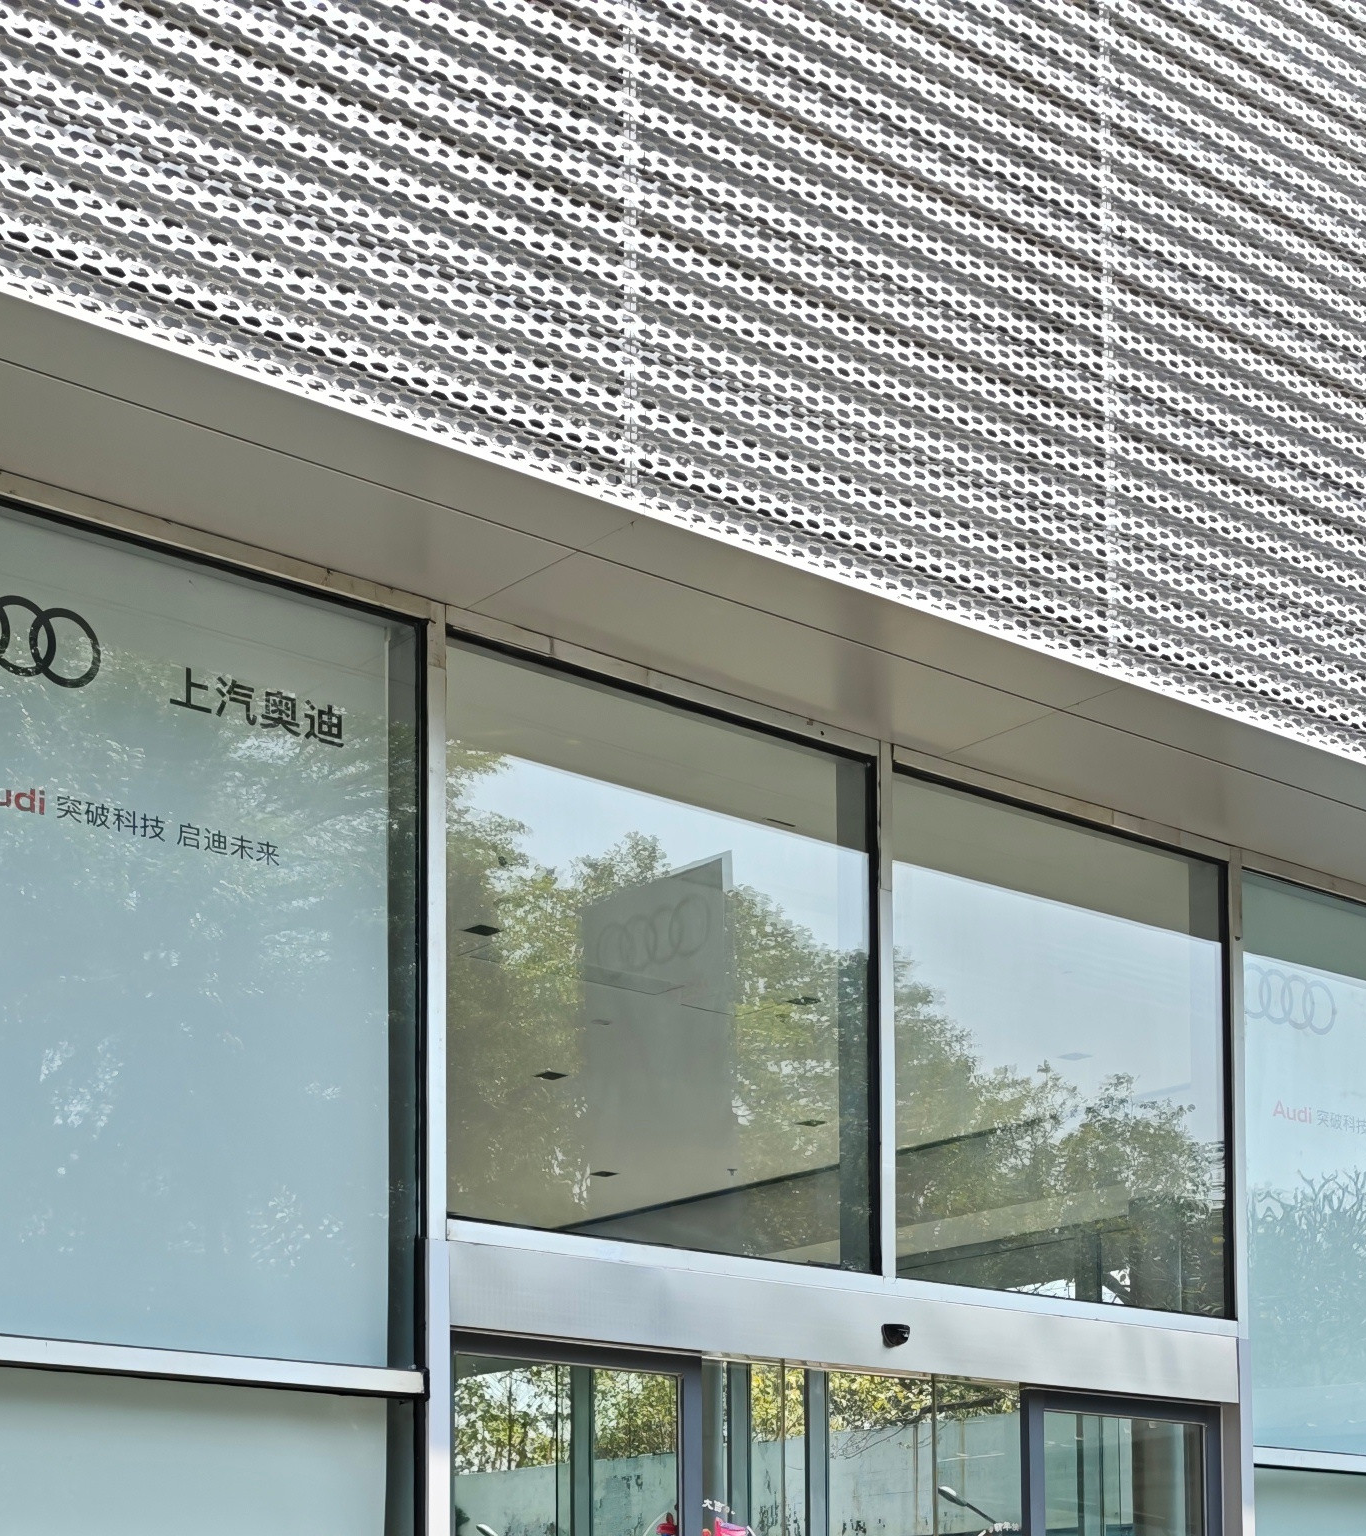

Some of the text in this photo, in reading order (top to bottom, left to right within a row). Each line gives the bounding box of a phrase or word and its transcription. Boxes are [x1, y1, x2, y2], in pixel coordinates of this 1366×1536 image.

[169, 667, 345, 748] 上汽奥迪
[56, 795, 166, 843] 突破科技
[176, 822, 280, 867] 启迪未来
[1272, 1100, 1312, 1124] Audi
